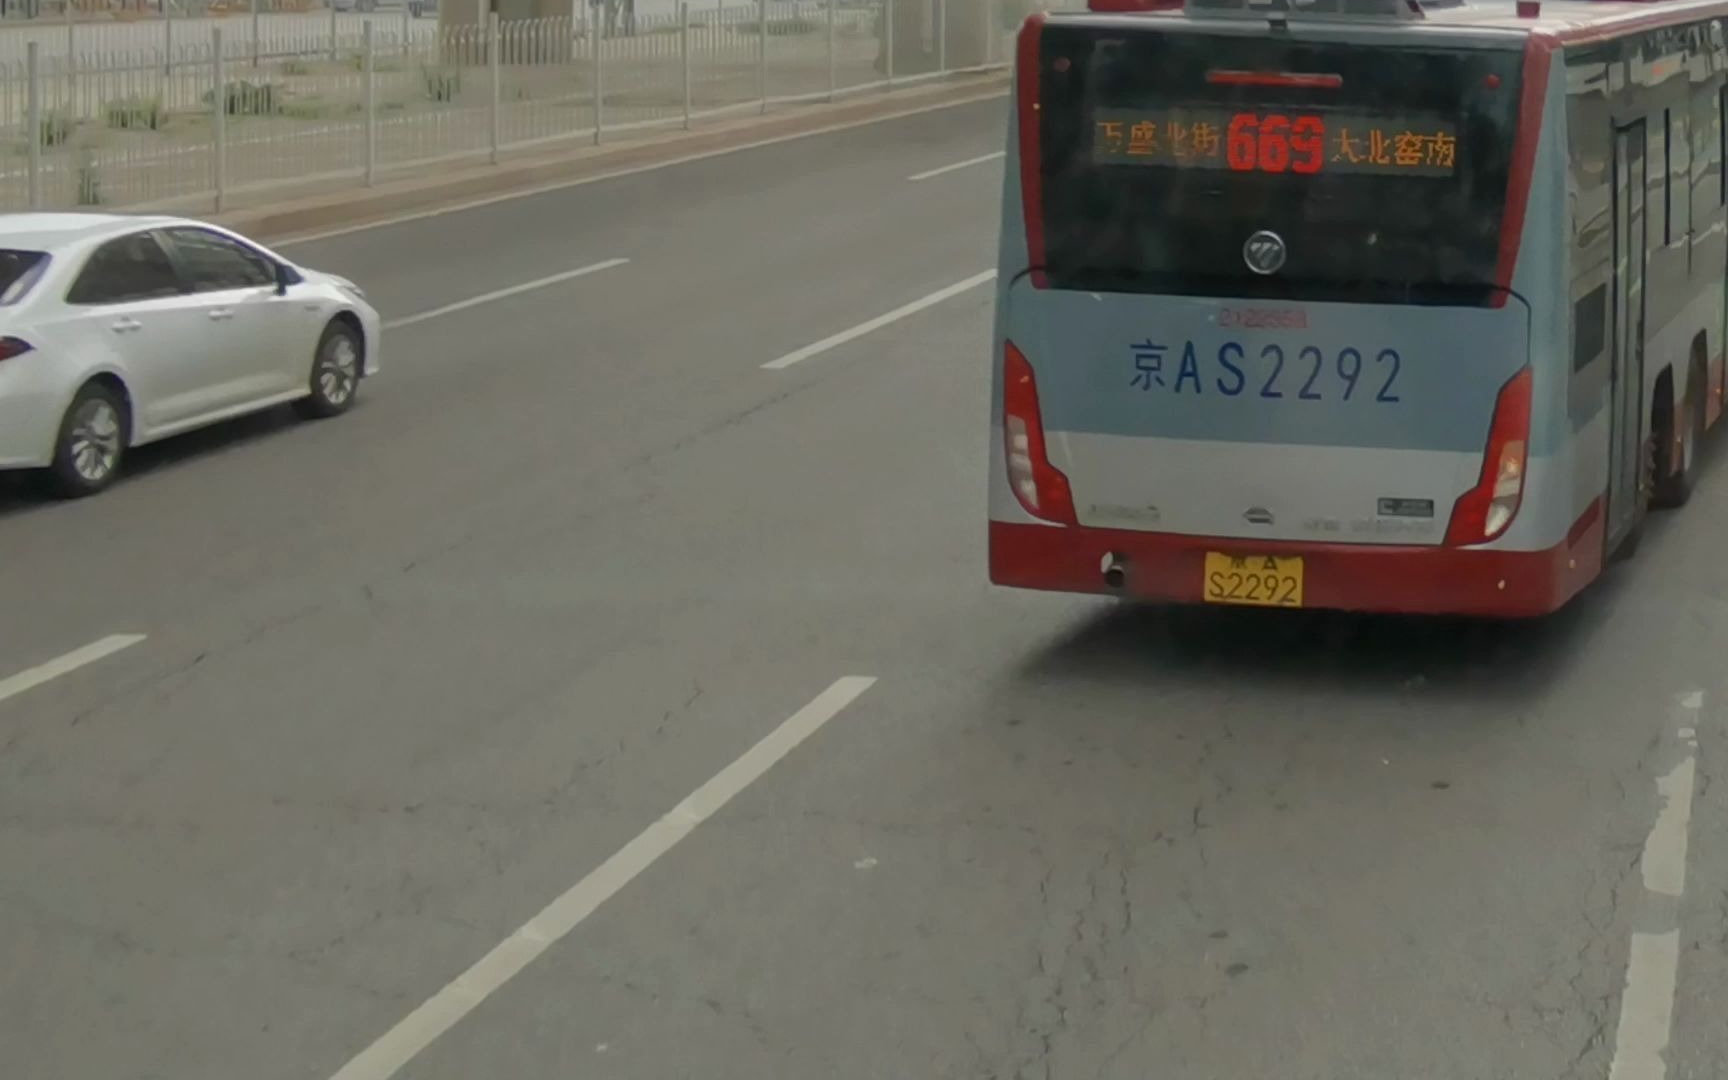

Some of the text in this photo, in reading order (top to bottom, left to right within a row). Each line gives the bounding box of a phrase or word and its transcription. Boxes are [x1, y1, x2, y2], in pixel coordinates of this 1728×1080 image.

[1227, 112, 1325, 173] 669
[1331, 127, 1456, 168] 大北窑南
[1129, 338, 1401, 403] 京AS2292
[1209, 571, 1297, 603] S2292
